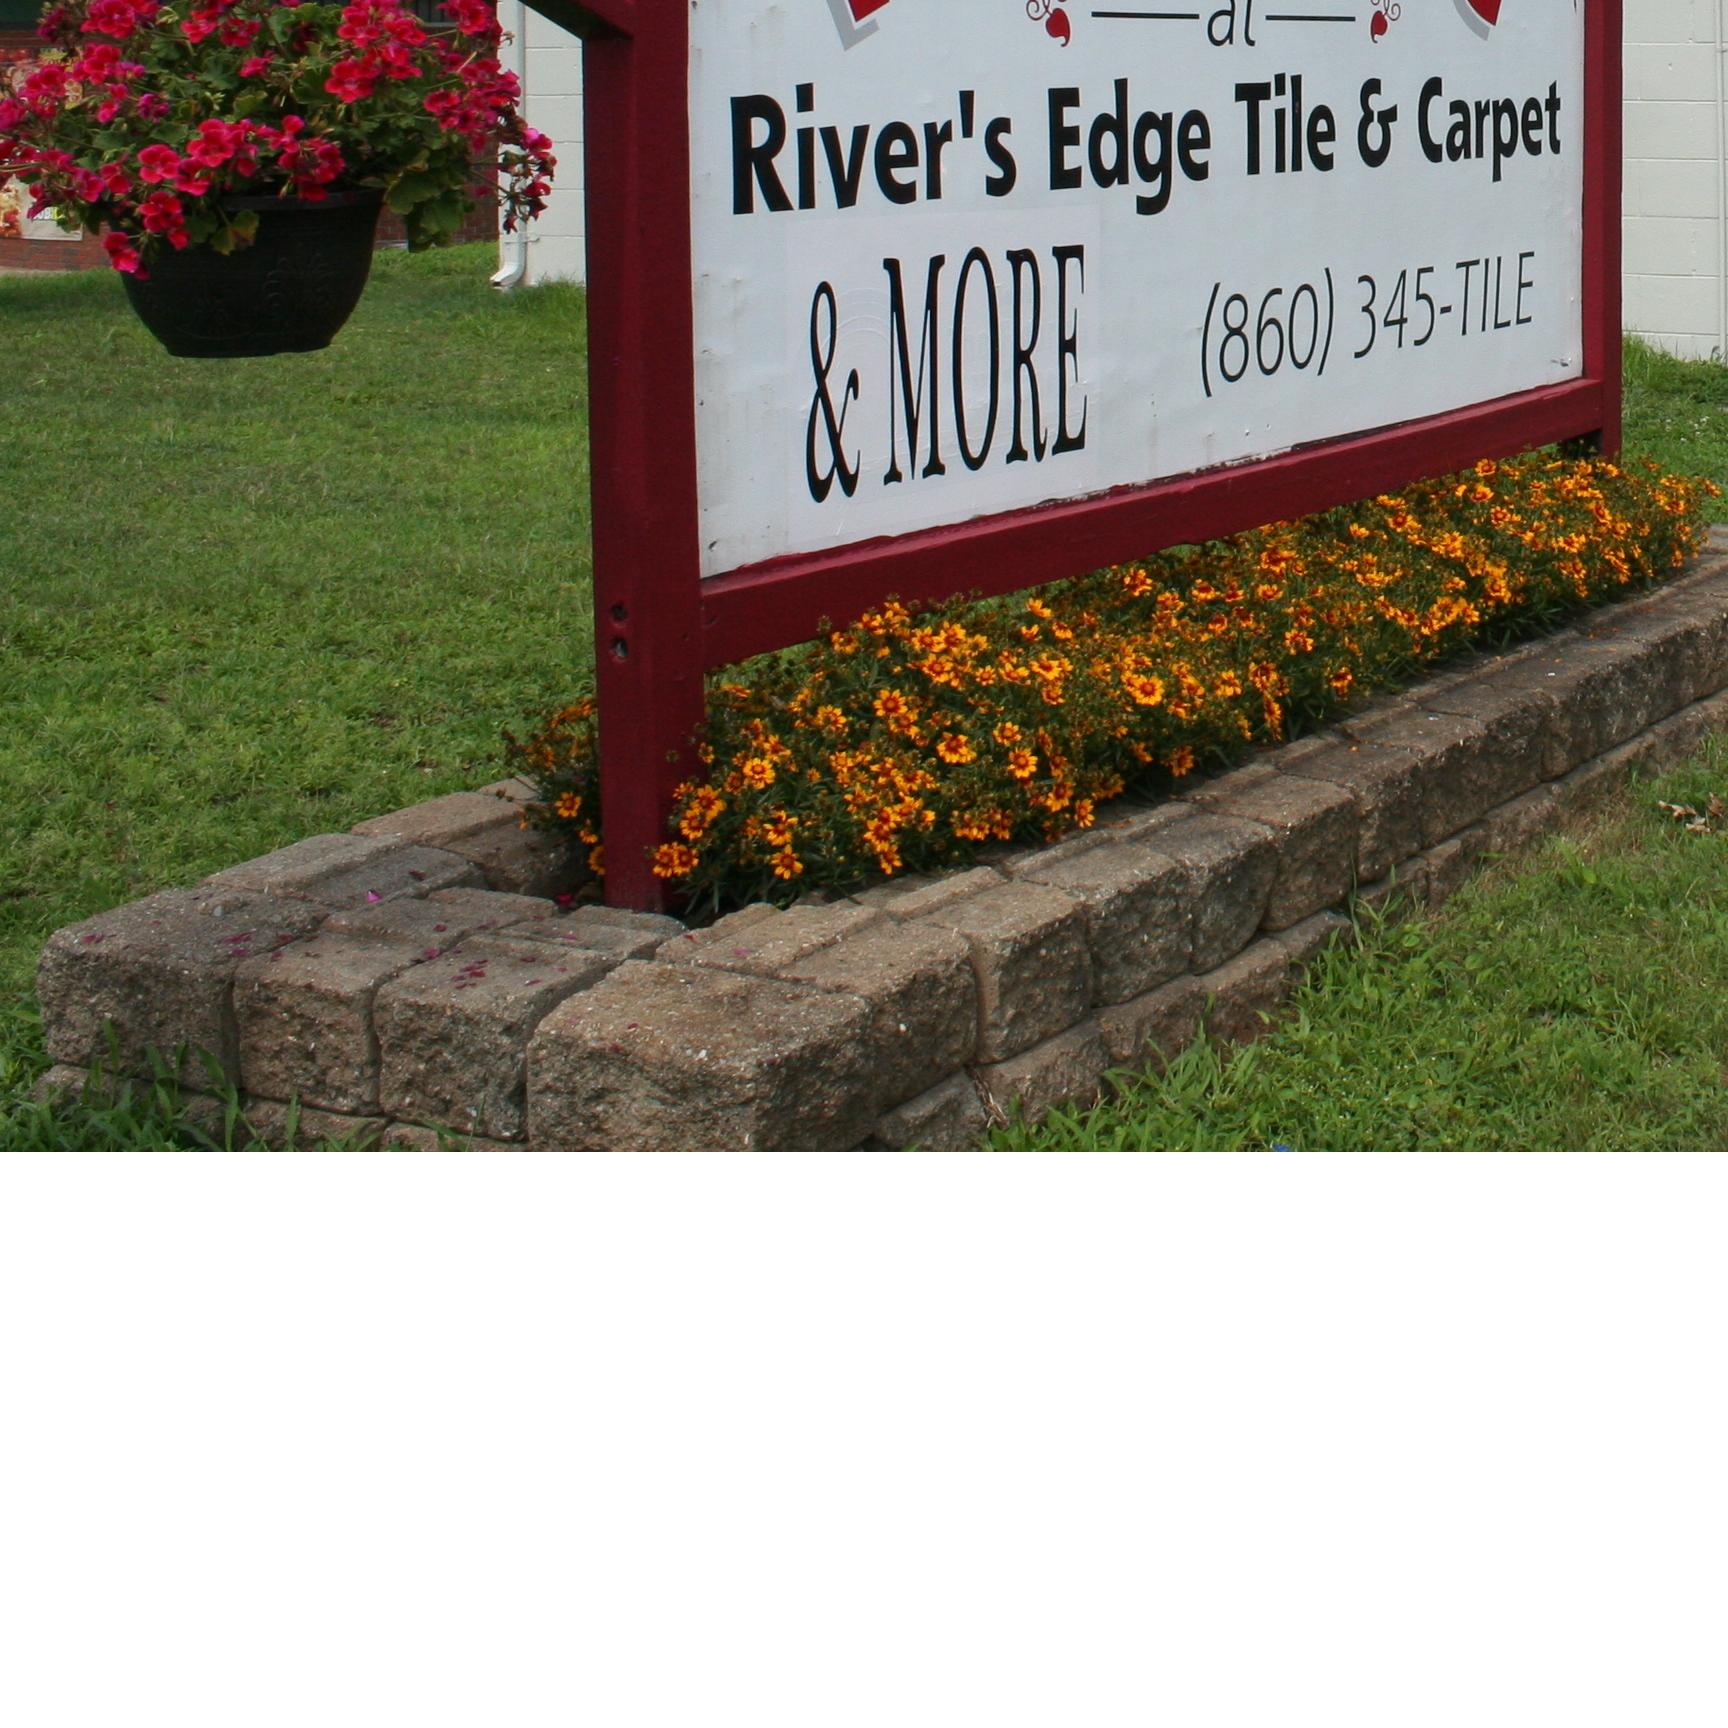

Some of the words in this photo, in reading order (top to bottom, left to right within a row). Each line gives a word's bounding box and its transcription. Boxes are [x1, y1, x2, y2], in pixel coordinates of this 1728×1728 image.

[730, 82, 1018, 215] River's
[1048, 78, 1212, 216] Edge
[1234, 72, 1336, 178] Tile
[1357, 78, 1398, 169] &
[1417, 77, 1562, 182] Carpet
[805, 280, 860, 504] &
[883, 244, 1088, 488] MORE
[1201, 266, 1334, 397] (860)
[1354, 251, 1536, 360] 345-TILE
